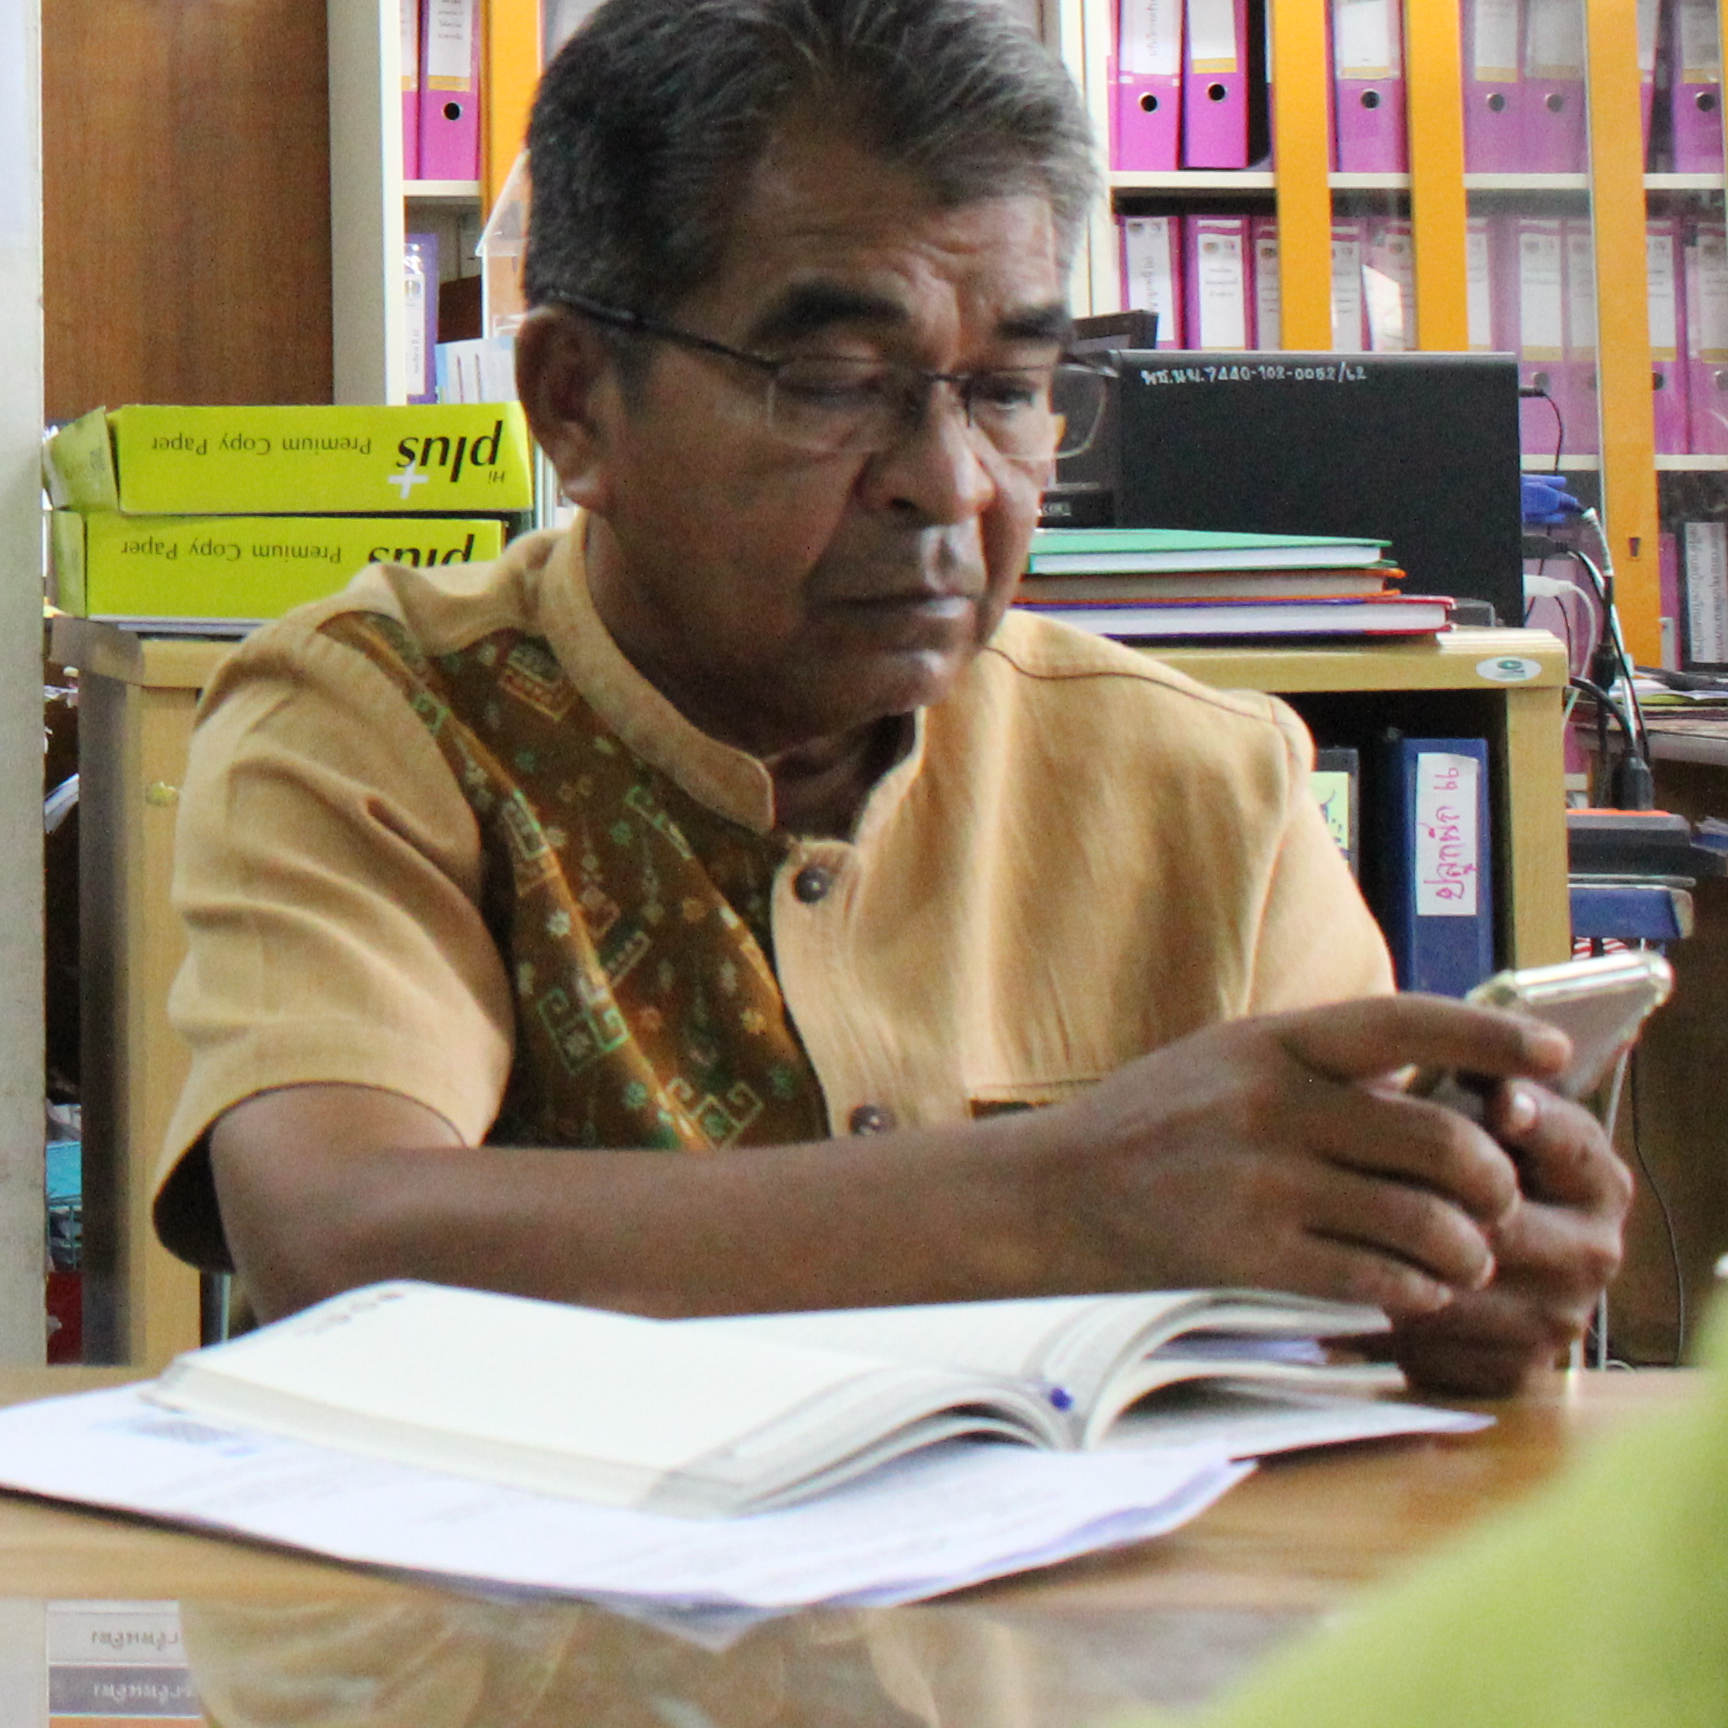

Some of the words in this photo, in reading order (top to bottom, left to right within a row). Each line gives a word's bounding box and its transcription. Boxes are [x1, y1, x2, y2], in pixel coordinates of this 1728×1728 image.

[152, 434, 208, 456] Paper
[217, 434, 272, 456] Copy
[281, 436, 372, 455] Premium
[395, 419, 503, 483] plus
[121, 538, 178, 561] Paper
[189, 541, 242, 561] Copy
[252, 539, 342, 561] Premium
